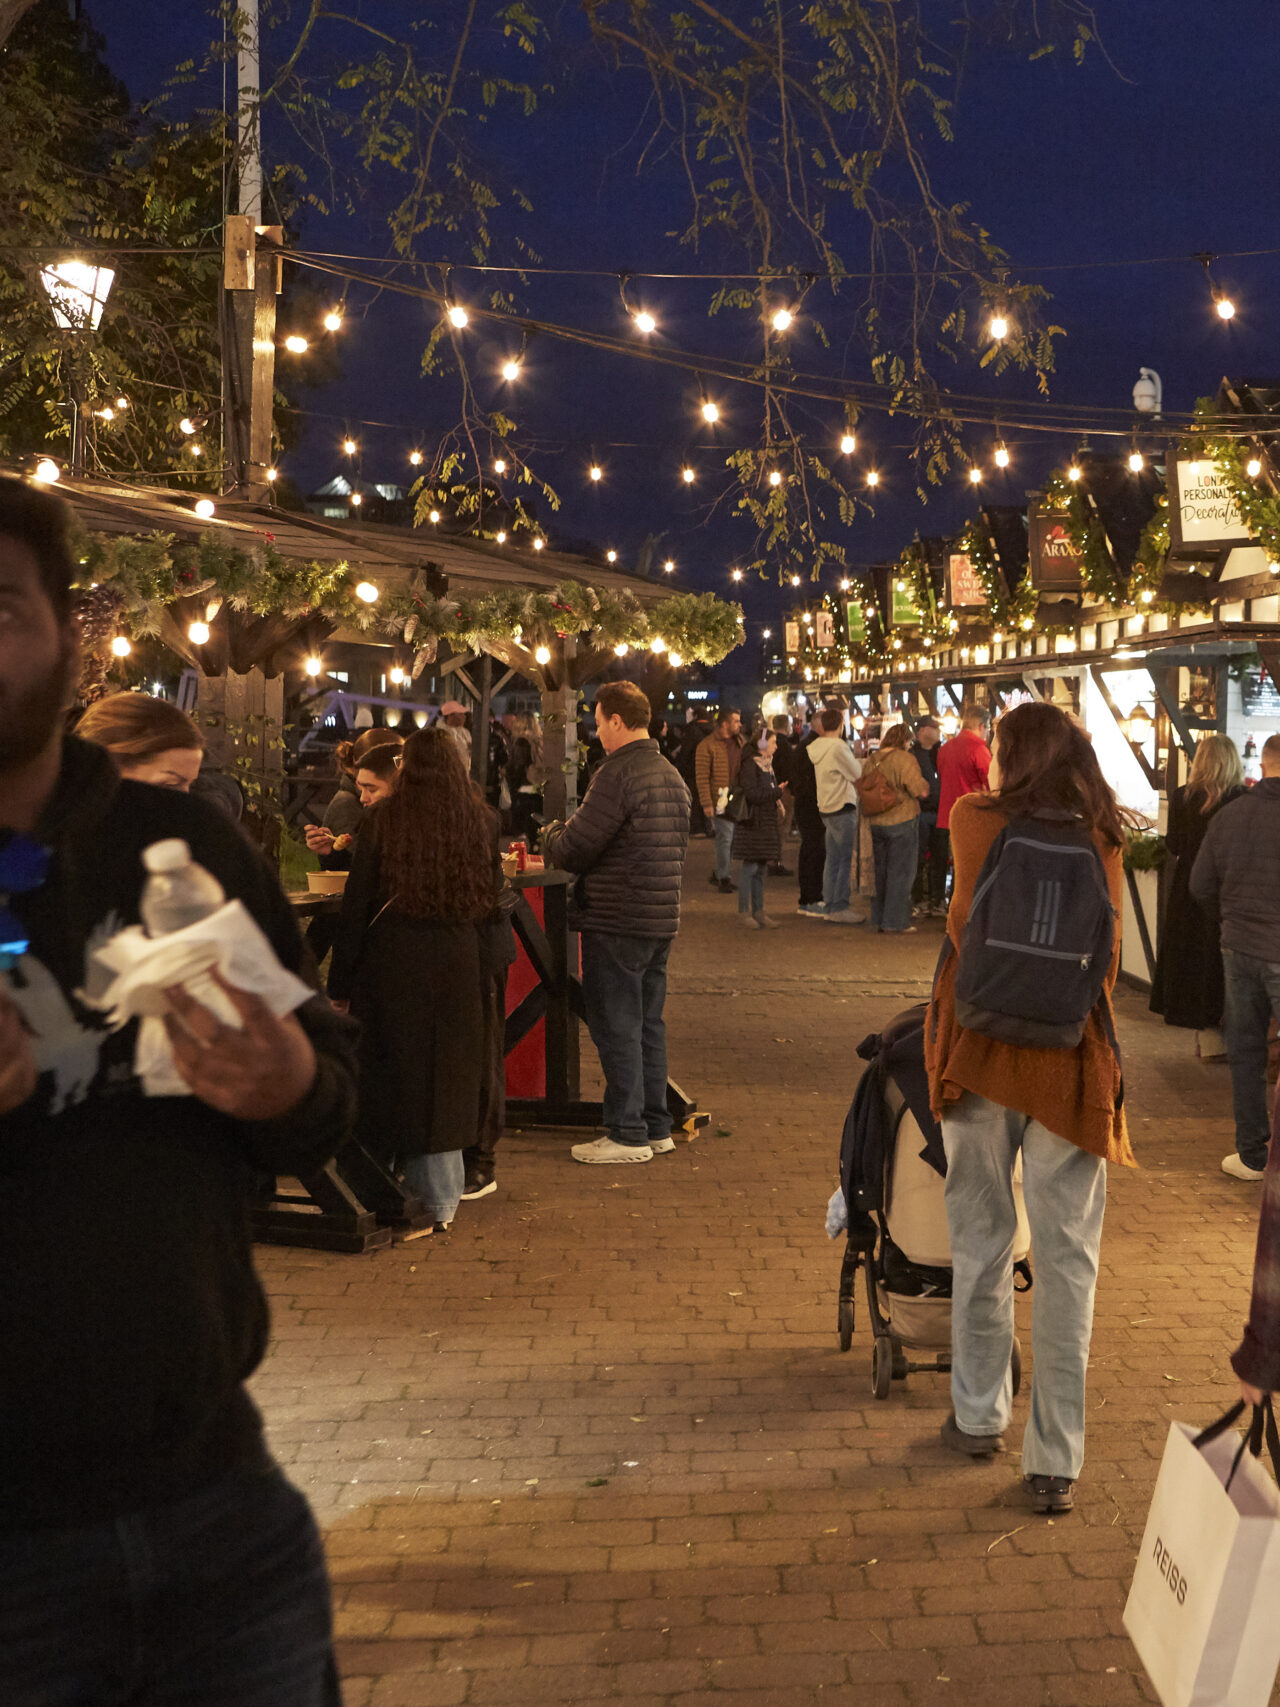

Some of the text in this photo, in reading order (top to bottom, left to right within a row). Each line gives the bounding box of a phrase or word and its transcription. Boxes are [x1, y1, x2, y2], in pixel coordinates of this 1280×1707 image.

[1184, 488, 1232, 500] PERSONALI
[1180, 500, 1241, 525] Decoratio
[1152, 1536, 1188, 1606] REISS
